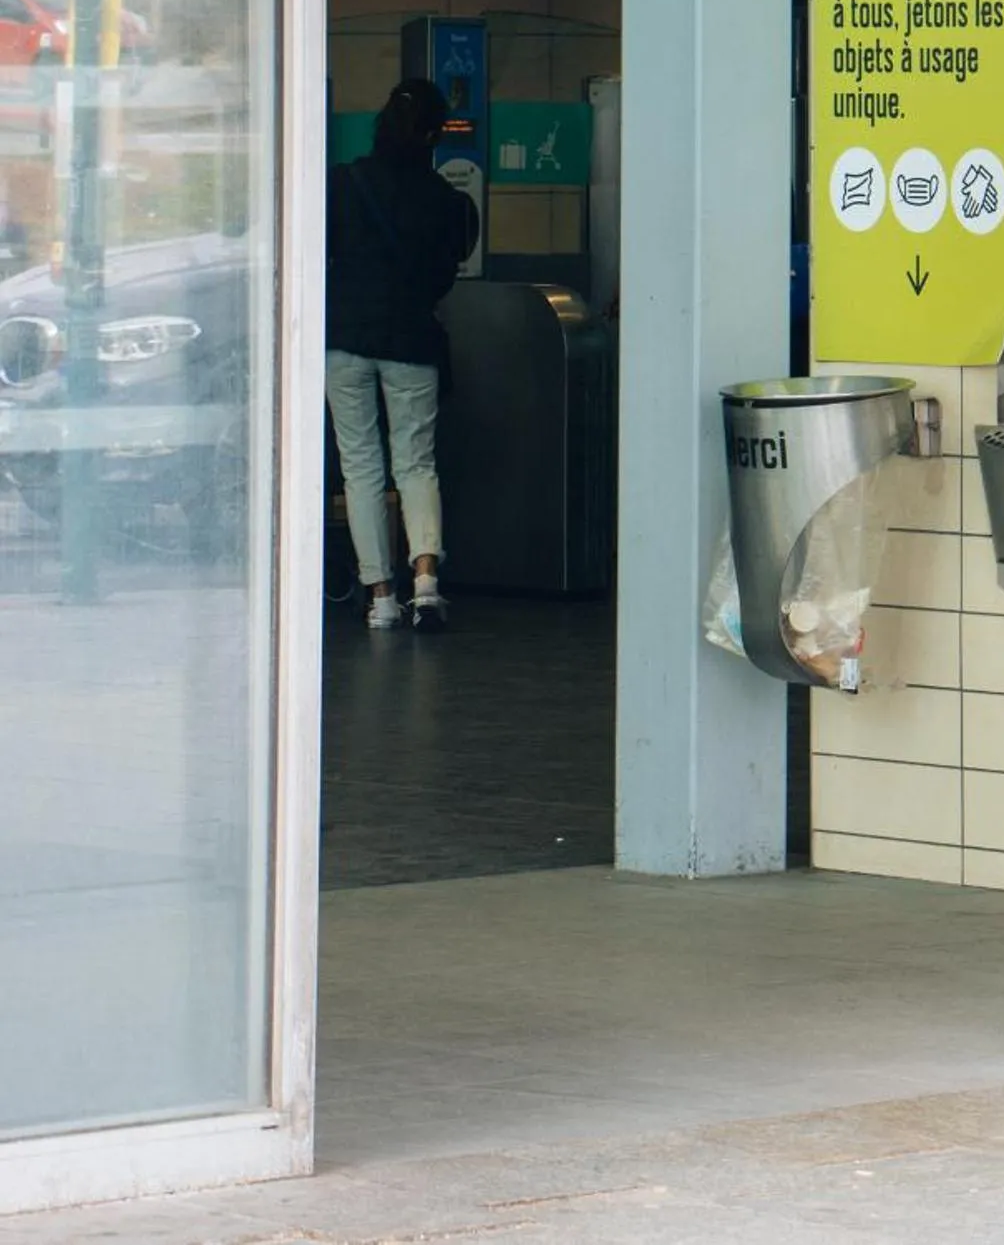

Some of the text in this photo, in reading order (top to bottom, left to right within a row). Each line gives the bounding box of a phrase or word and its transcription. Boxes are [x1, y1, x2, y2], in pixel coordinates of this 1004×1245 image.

[833, 38, 979, 83] objets à usage
[833, 87, 905, 127] unique.
[733, 430, 788, 470] erci
